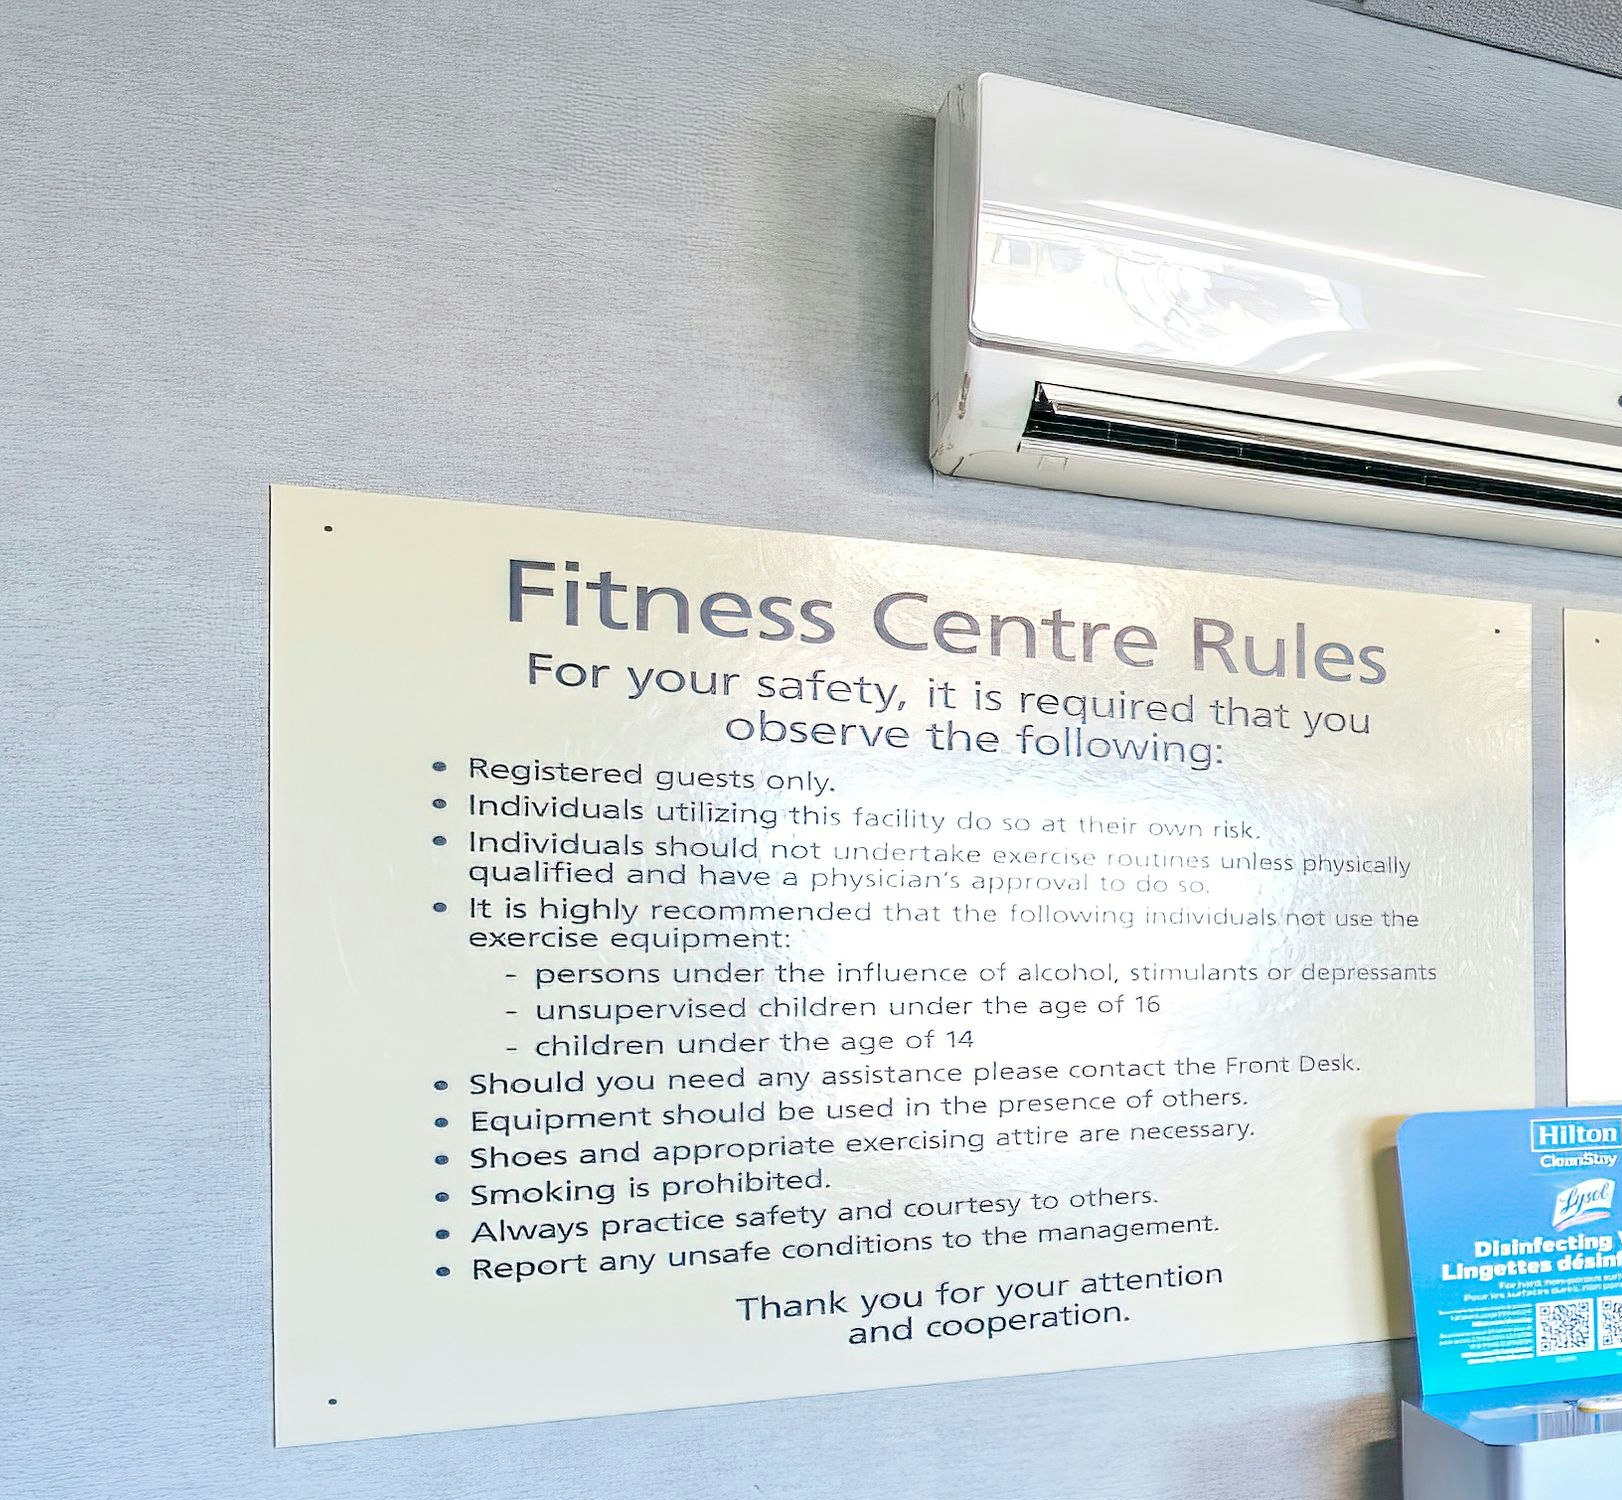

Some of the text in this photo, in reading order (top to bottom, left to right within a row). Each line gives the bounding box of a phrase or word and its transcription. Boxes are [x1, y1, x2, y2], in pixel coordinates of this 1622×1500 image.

[509, 559, 1386, 684] Fitness Centre Rules
[529, 653, 1369, 738] For your safety, it is required that you
[726, 710, 1222, 771] observe the following:
[470, 757, 834, 797] Registered guests only.
[470, 926, 789, 953] exercise equipment:
[537, 961, 1436, 989] persons under the influence of alcohol, stimulants or depressants
[537, 993, 1160, 1024] unsupervised children under the age of 16
[471, 1053, 1360, 1097] Should you need any assistance please contact the Front Desk.
[1539, 1123, 1617, 1145] Hilton
[472, 1168, 830, 1205] Smoking is prohibited.
[1559, 1182, 1610, 1216] Lysol
[471, 1187, 1158, 1243] Always practice safety and courtesy to others.
[474, 1215, 1218, 1282] Report any unsafe conditions to the management.
[1475, 1233, 1612, 1257] Disinfecting
[1442, 1259, 1552, 1281] Lingettes
[736, 1264, 1222, 1320] Thank you for your attention
[849, 1304, 1129, 1344] and cooperation.
